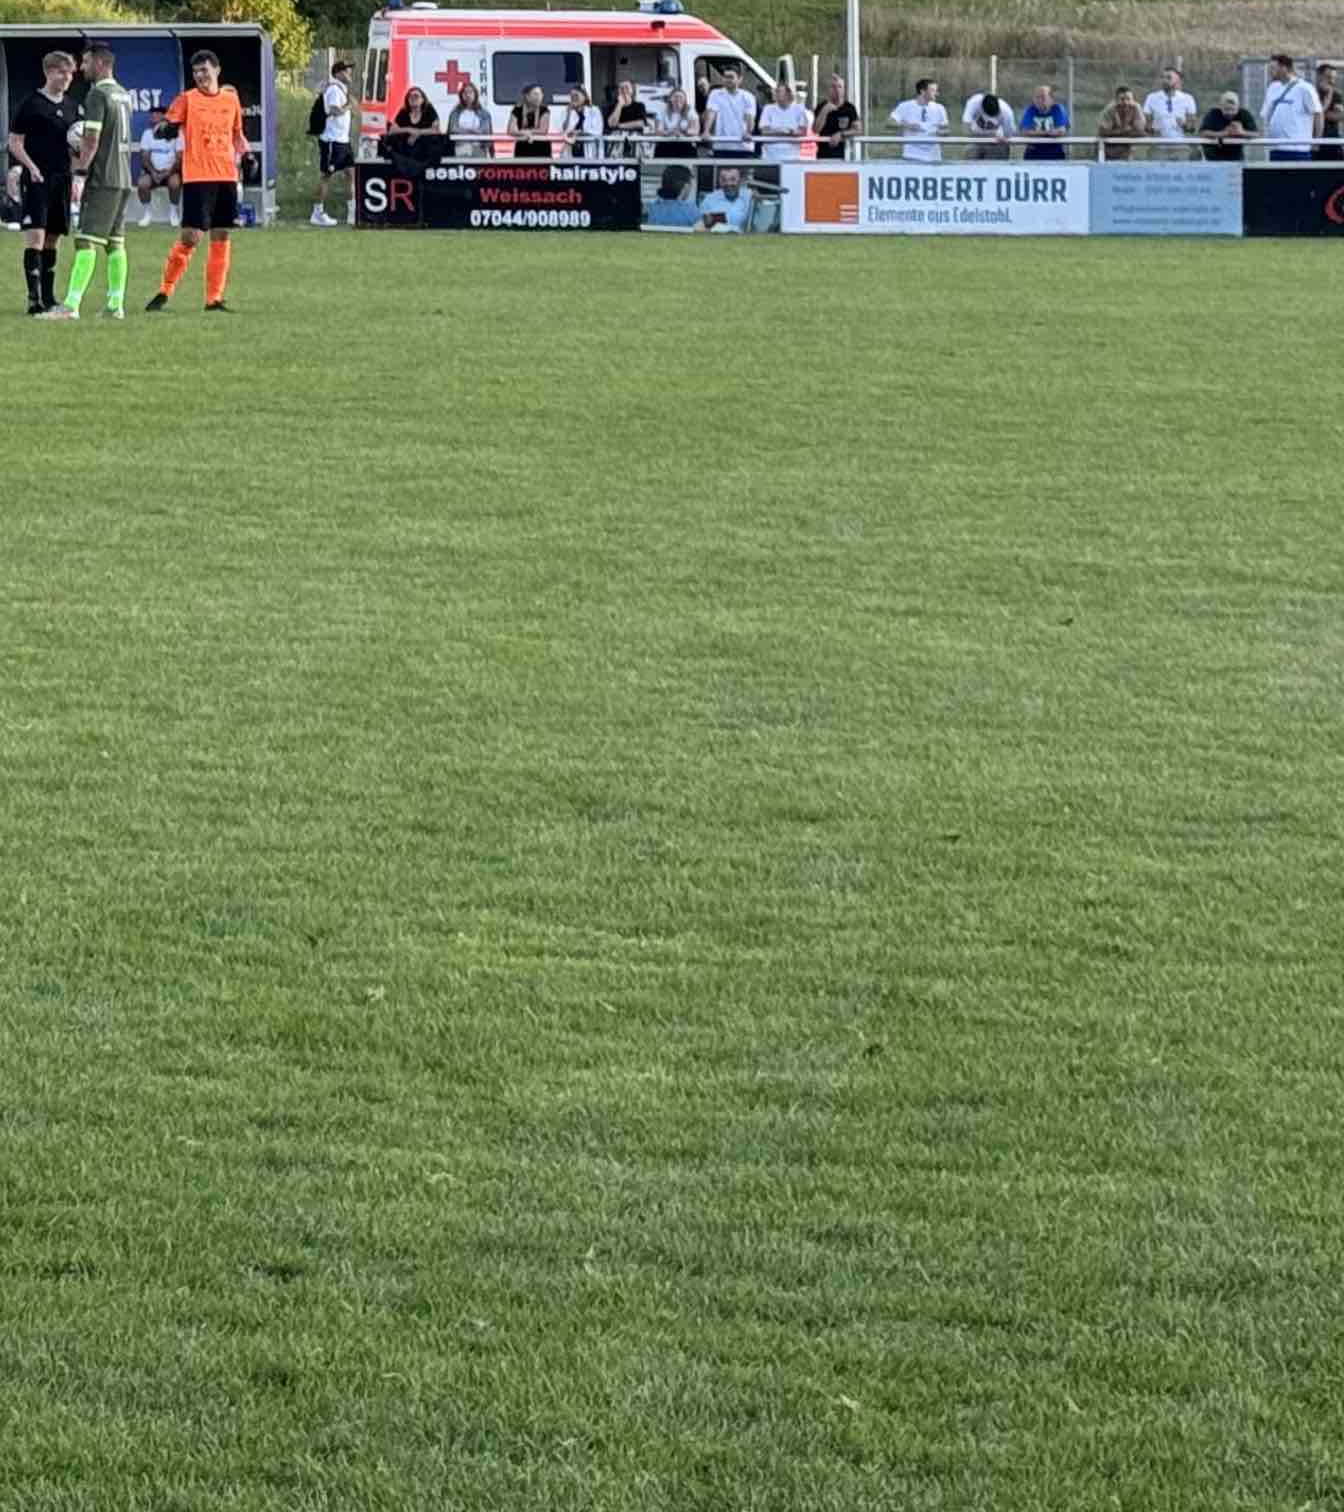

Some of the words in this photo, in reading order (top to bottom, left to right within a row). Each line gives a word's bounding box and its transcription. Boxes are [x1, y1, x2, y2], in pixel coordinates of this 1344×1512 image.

[364, 177, 415, 213] SR
[867, 175, 987, 202] NORBERT
[995, 171, 1067, 203] DÜRR
[479, 188, 583, 205] Weissach
[470, 210, 592, 228] 07044/908989
[867, 206, 926, 223] Elemente
[928, 209, 949, 223] aus
